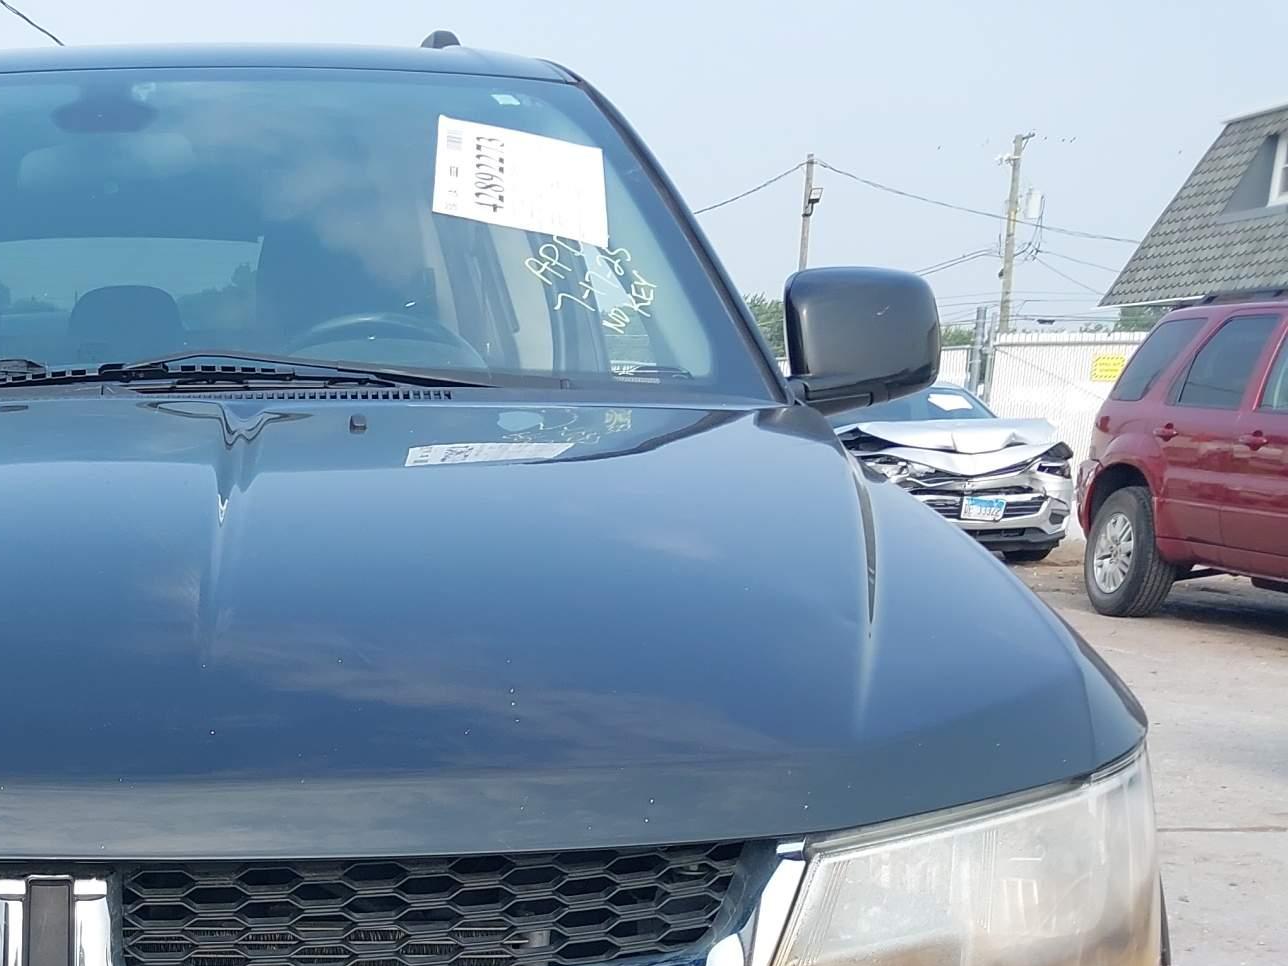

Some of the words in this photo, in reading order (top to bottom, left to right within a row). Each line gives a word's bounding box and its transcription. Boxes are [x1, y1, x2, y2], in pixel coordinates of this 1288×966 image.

[474, 136, 505, 213] 42892273
[601, 306, 631, 334] NO
[622, 268, 657, 318] KEY
